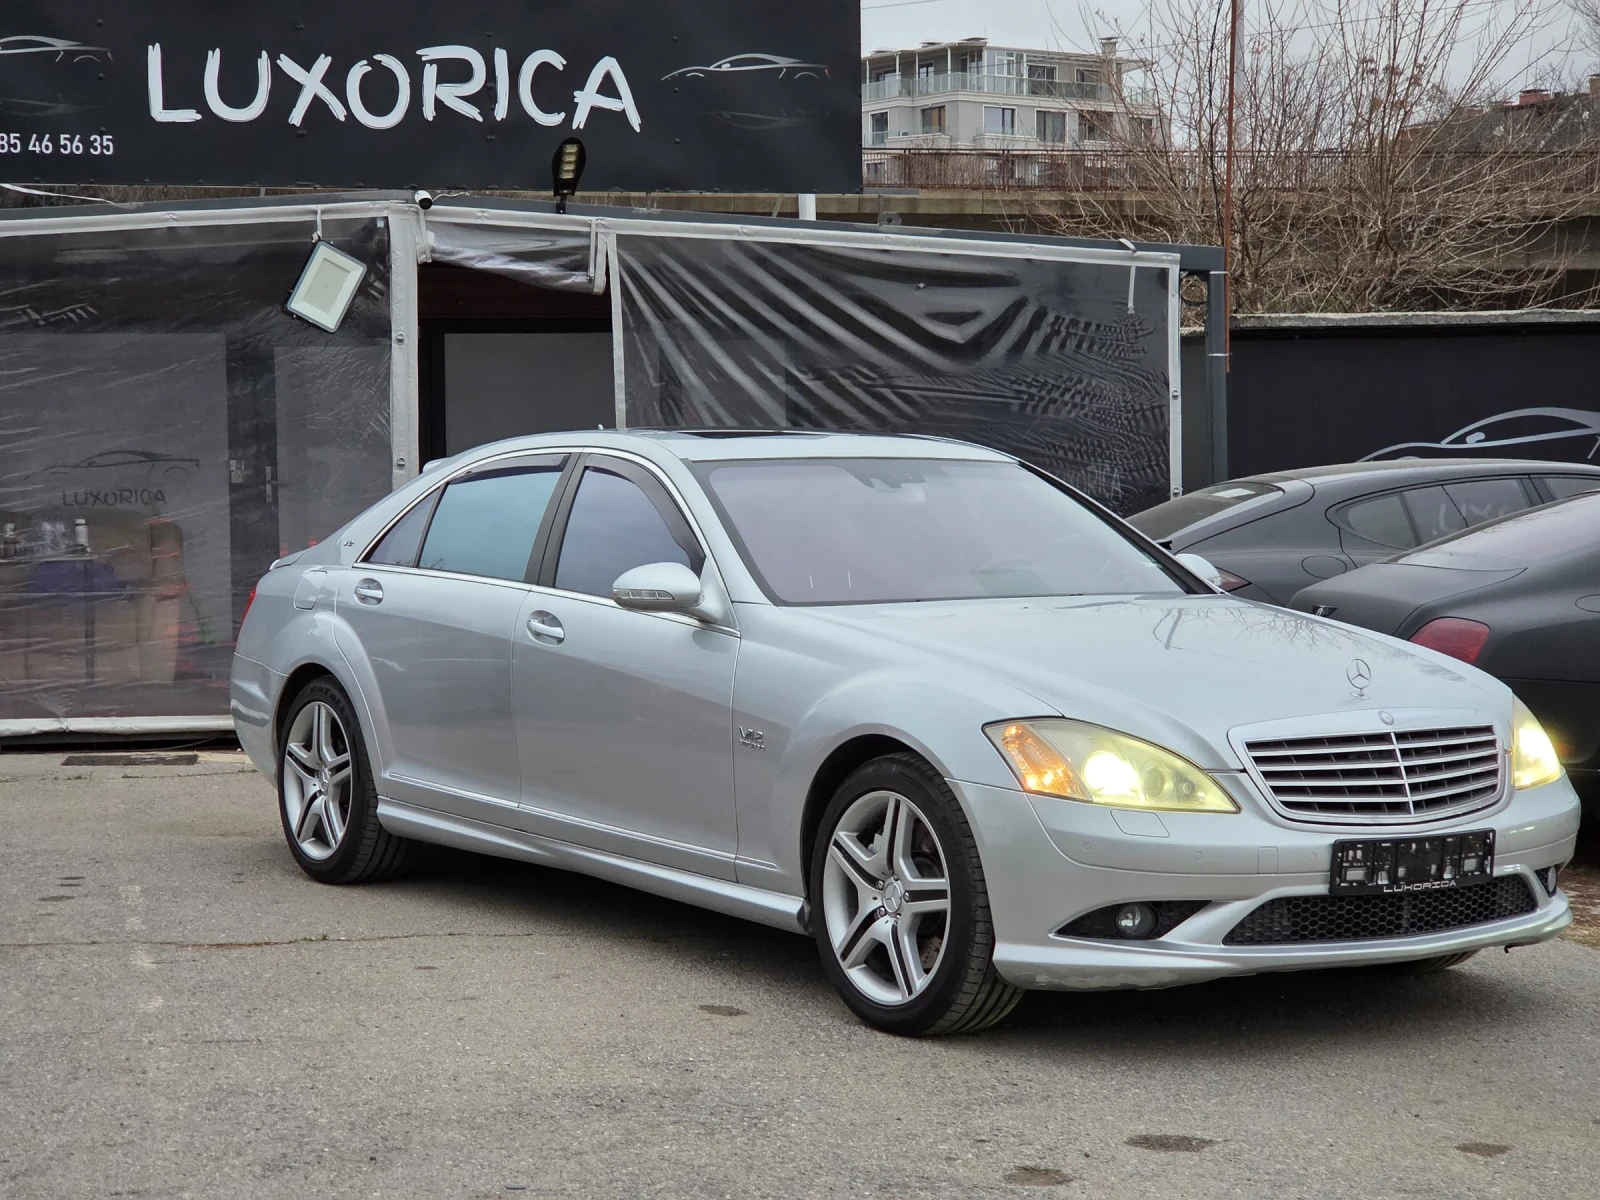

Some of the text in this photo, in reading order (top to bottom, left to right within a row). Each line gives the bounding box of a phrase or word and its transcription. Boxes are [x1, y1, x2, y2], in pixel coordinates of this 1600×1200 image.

[147, 42, 642, 133] LUXORICA
[28, 133, 53, 154] 46
[60, 134, 83, 155] 56
[89, 135, 114, 155] 35
[62, 488, 167, 507] LUXORICA
[738, 725, 764, 744] V12
[1383, 880, 1457, 893] LUXORICA
